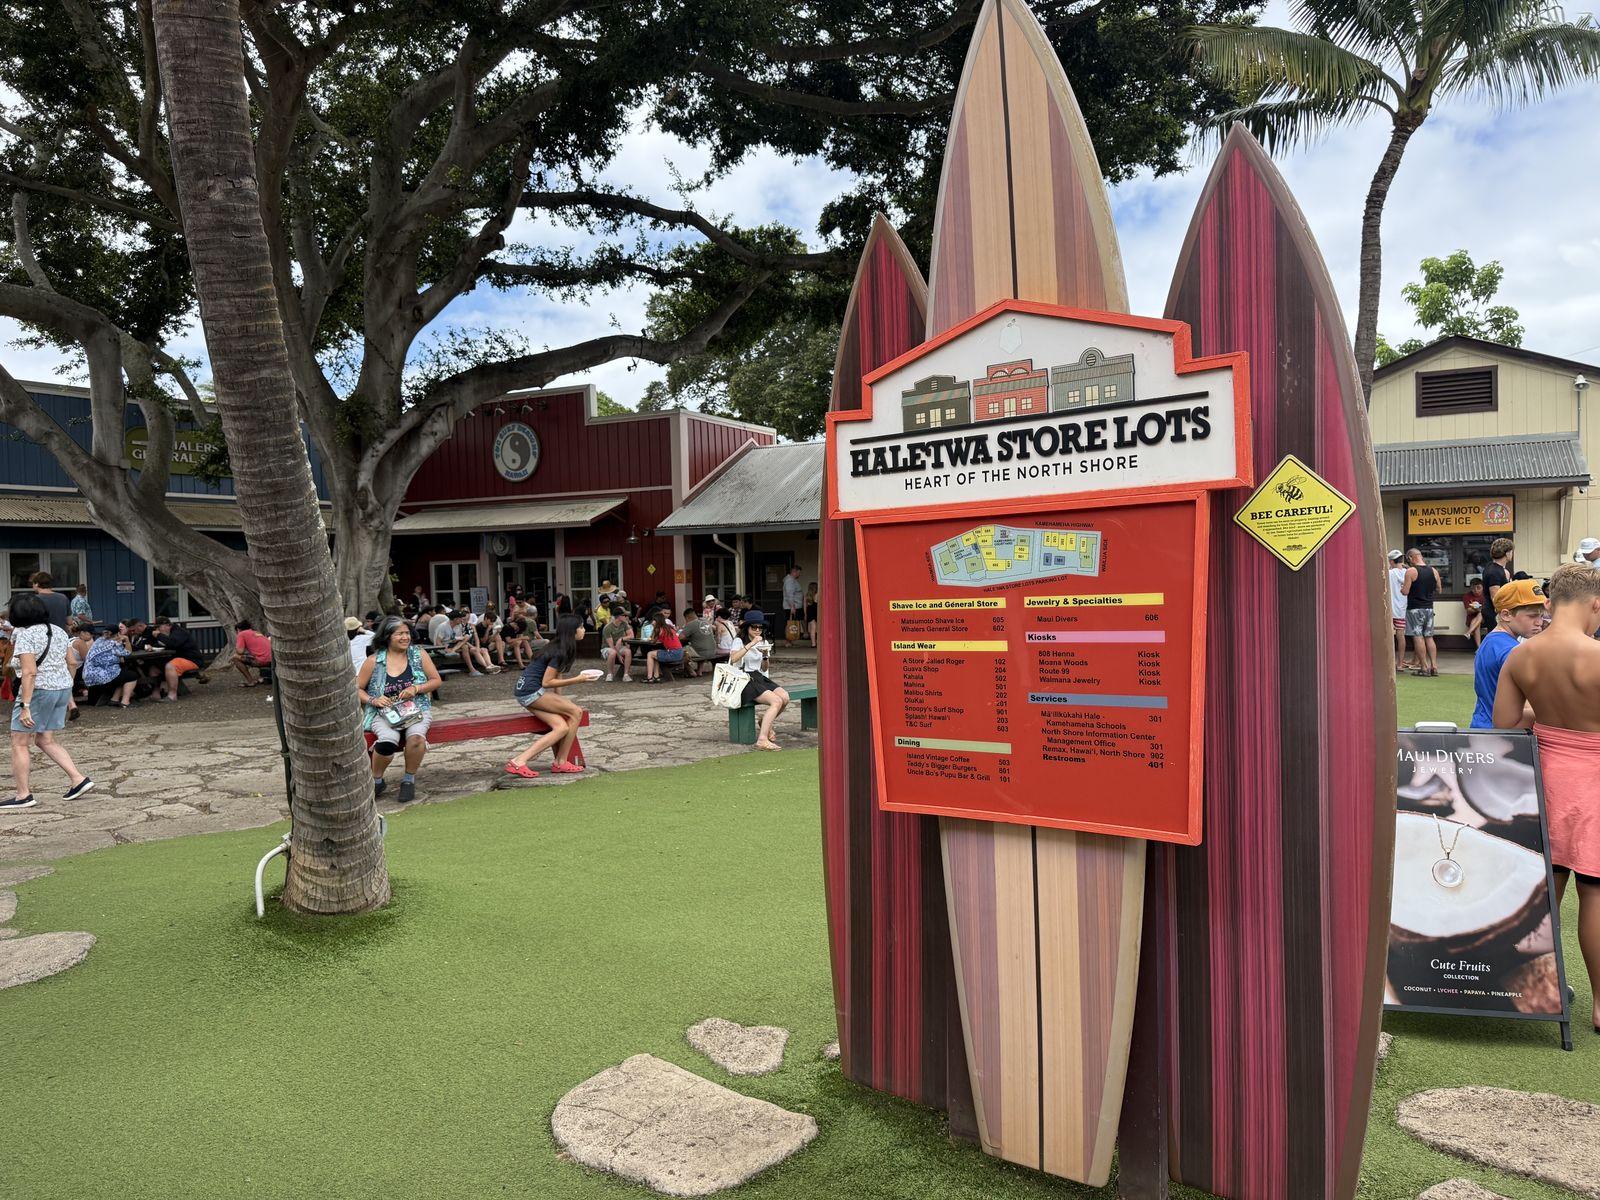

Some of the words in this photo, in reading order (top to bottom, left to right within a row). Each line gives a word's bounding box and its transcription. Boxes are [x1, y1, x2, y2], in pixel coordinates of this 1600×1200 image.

[997, 420, 1108, 462] STORE
[1113, 406, 1211, 448] LOTS
[905, 474, 950, 490] HEART
[957, 471, 975, 485] OF
[981, 468, 1010, 483] THE
[1017, 462, 1072, 479] NORTH
[1080, 455, 1138, 473] SHORE
[1250, 511, 1272, 520] BEE
[1276, 505, 1332, 518] CAREFUL!
[1422, 506, 1480, 516] MATSUMOTO
[1418, 518, 1451, 526] SHAVE
[1072, 597, 1122, 605] Specialties
[1086, 730, 1127, 739] Information
[898, 739, 920, 747] Dining
[1047, 737, 1092, 746] Management
[1043, 754, 1086, 763] Restrooms
[1436, 750, 1494, 763] DIVERS
[953, 764, 977, 772] Burgers
[1431, 959, 1456, 971] Cute
[1459, 960, 1491, 972] Fruits
